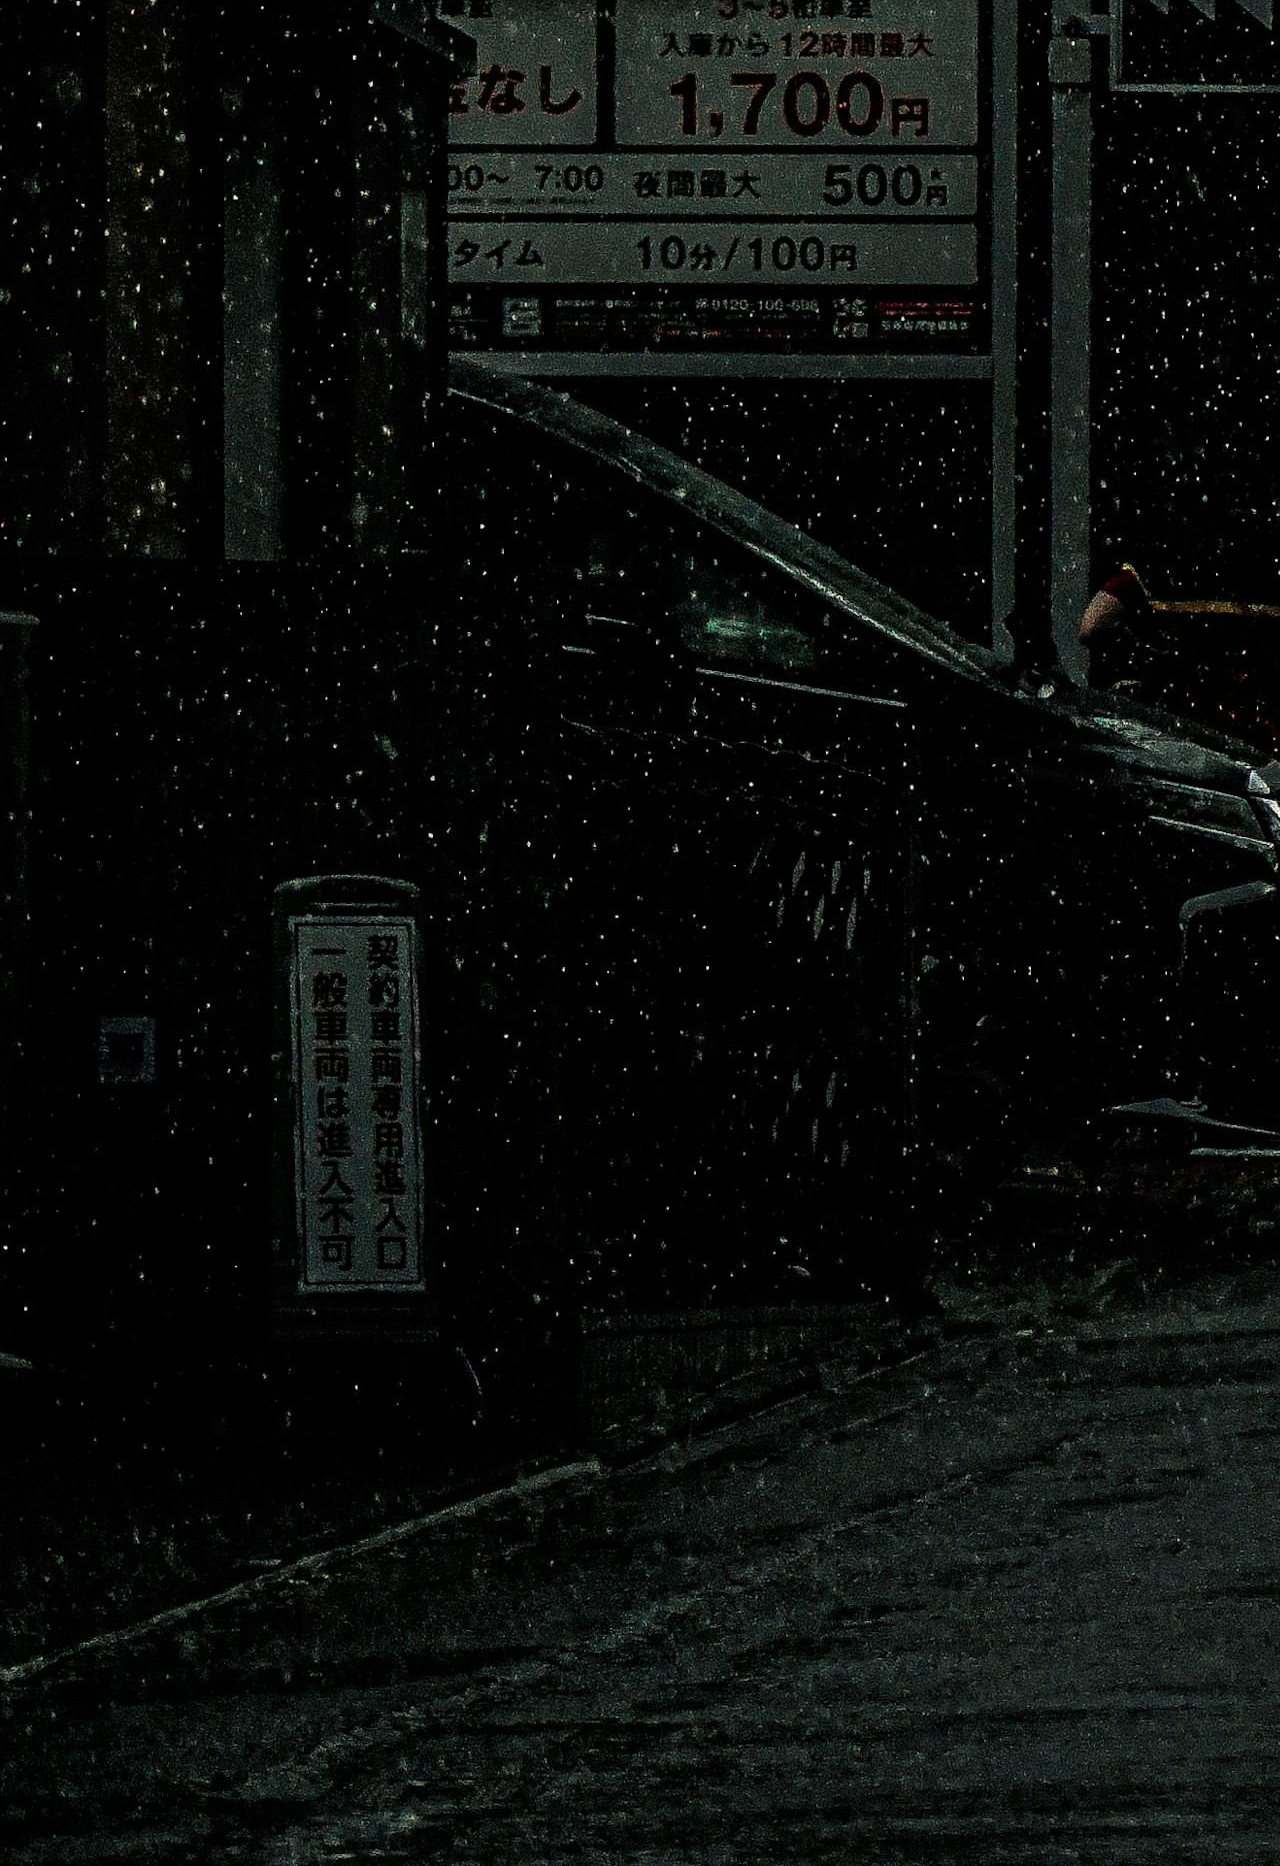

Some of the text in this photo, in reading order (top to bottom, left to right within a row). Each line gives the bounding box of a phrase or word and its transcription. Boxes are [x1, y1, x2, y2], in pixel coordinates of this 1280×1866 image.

[669, 70, 930, 138] 1,700円
[533, 164, 604, 191] 7:00
[632, 169, 762, 200] 夜間最大
[636, 234, 858, 273] 10分/100円
[310, 947, 355, 1273] 一般車両は進入不可
[367, 933, 408, 1271] 契約車両専用進入口
